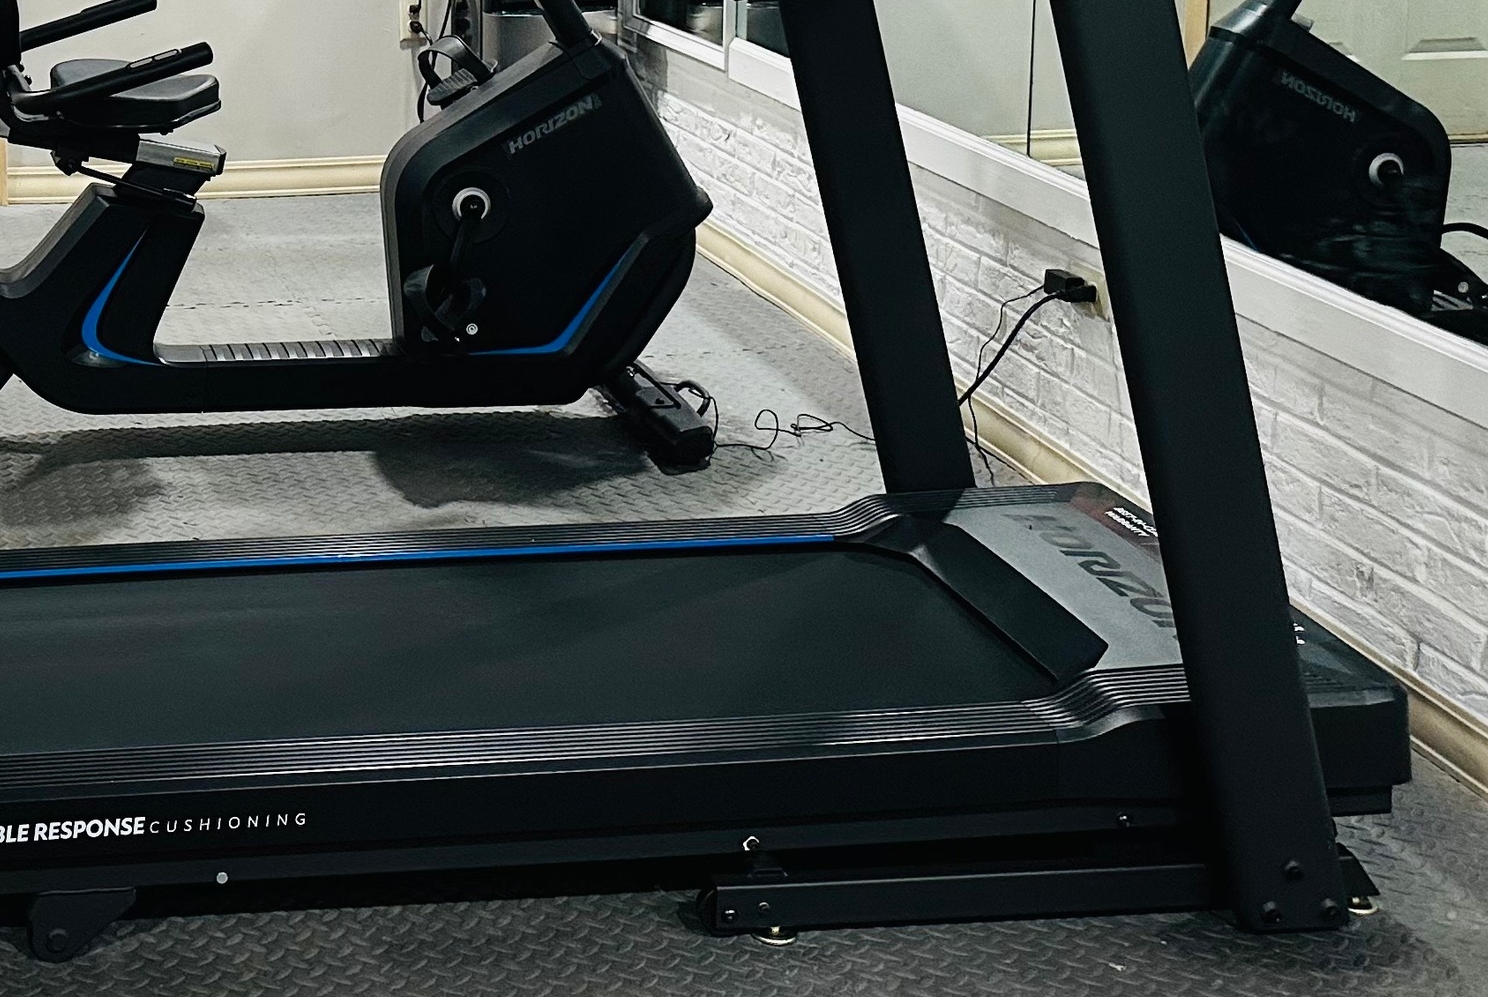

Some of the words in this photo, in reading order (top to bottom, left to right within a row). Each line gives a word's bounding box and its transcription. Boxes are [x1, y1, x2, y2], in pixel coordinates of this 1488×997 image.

[508, 94, 593, 154] HORIZON
[33, 816, 146, 842] RESPONSE
[149, 813, 307, 834] CUSHIONING
